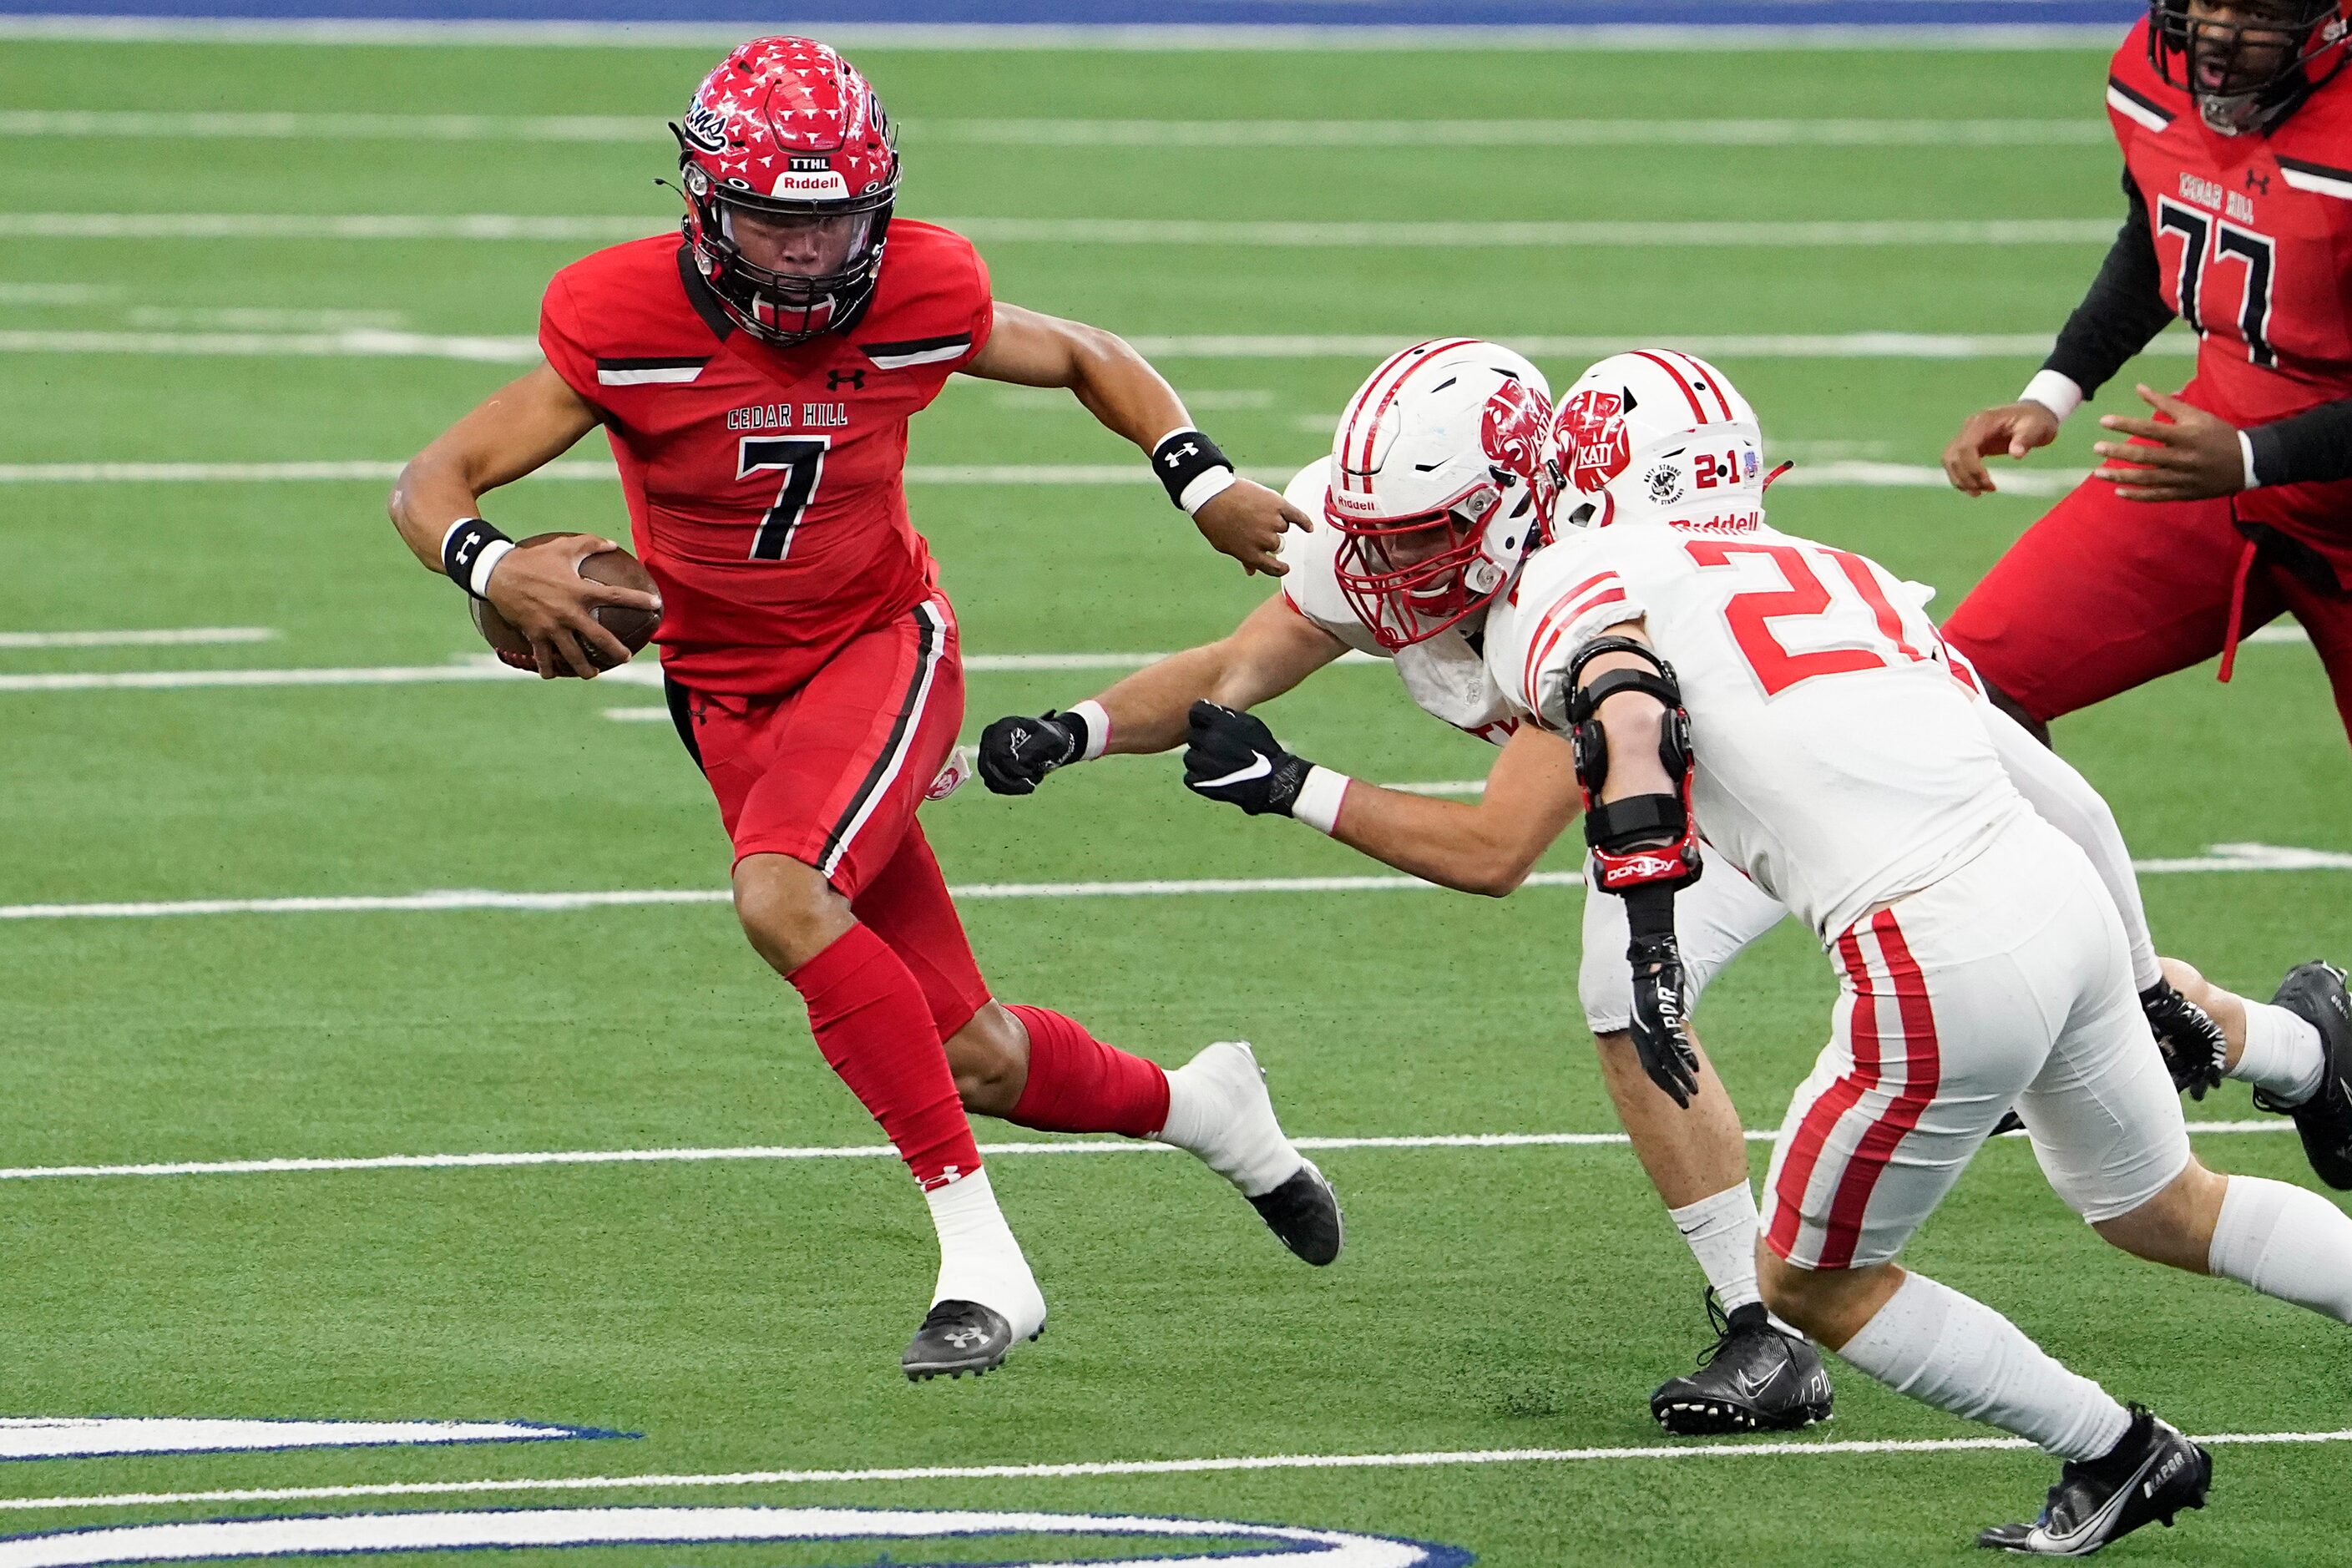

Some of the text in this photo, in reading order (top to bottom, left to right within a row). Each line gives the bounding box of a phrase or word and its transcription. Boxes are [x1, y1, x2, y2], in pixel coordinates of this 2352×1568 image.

[790, 158, 829, 169] TTHL
[784, 176, 838, 190] Riddell
[2179, 171, 2253, 225] CEDAR HILL
[2156, 192, 2278, 367] 77
[727, 402, 848, 430] CEDAR HILL
[1579, 442, 1616, 467] KATY
[735, 434, 832, 561] 7
[1338, 495, 1375, 511] Riddell
[1678, 539, 1935, 703] 21
